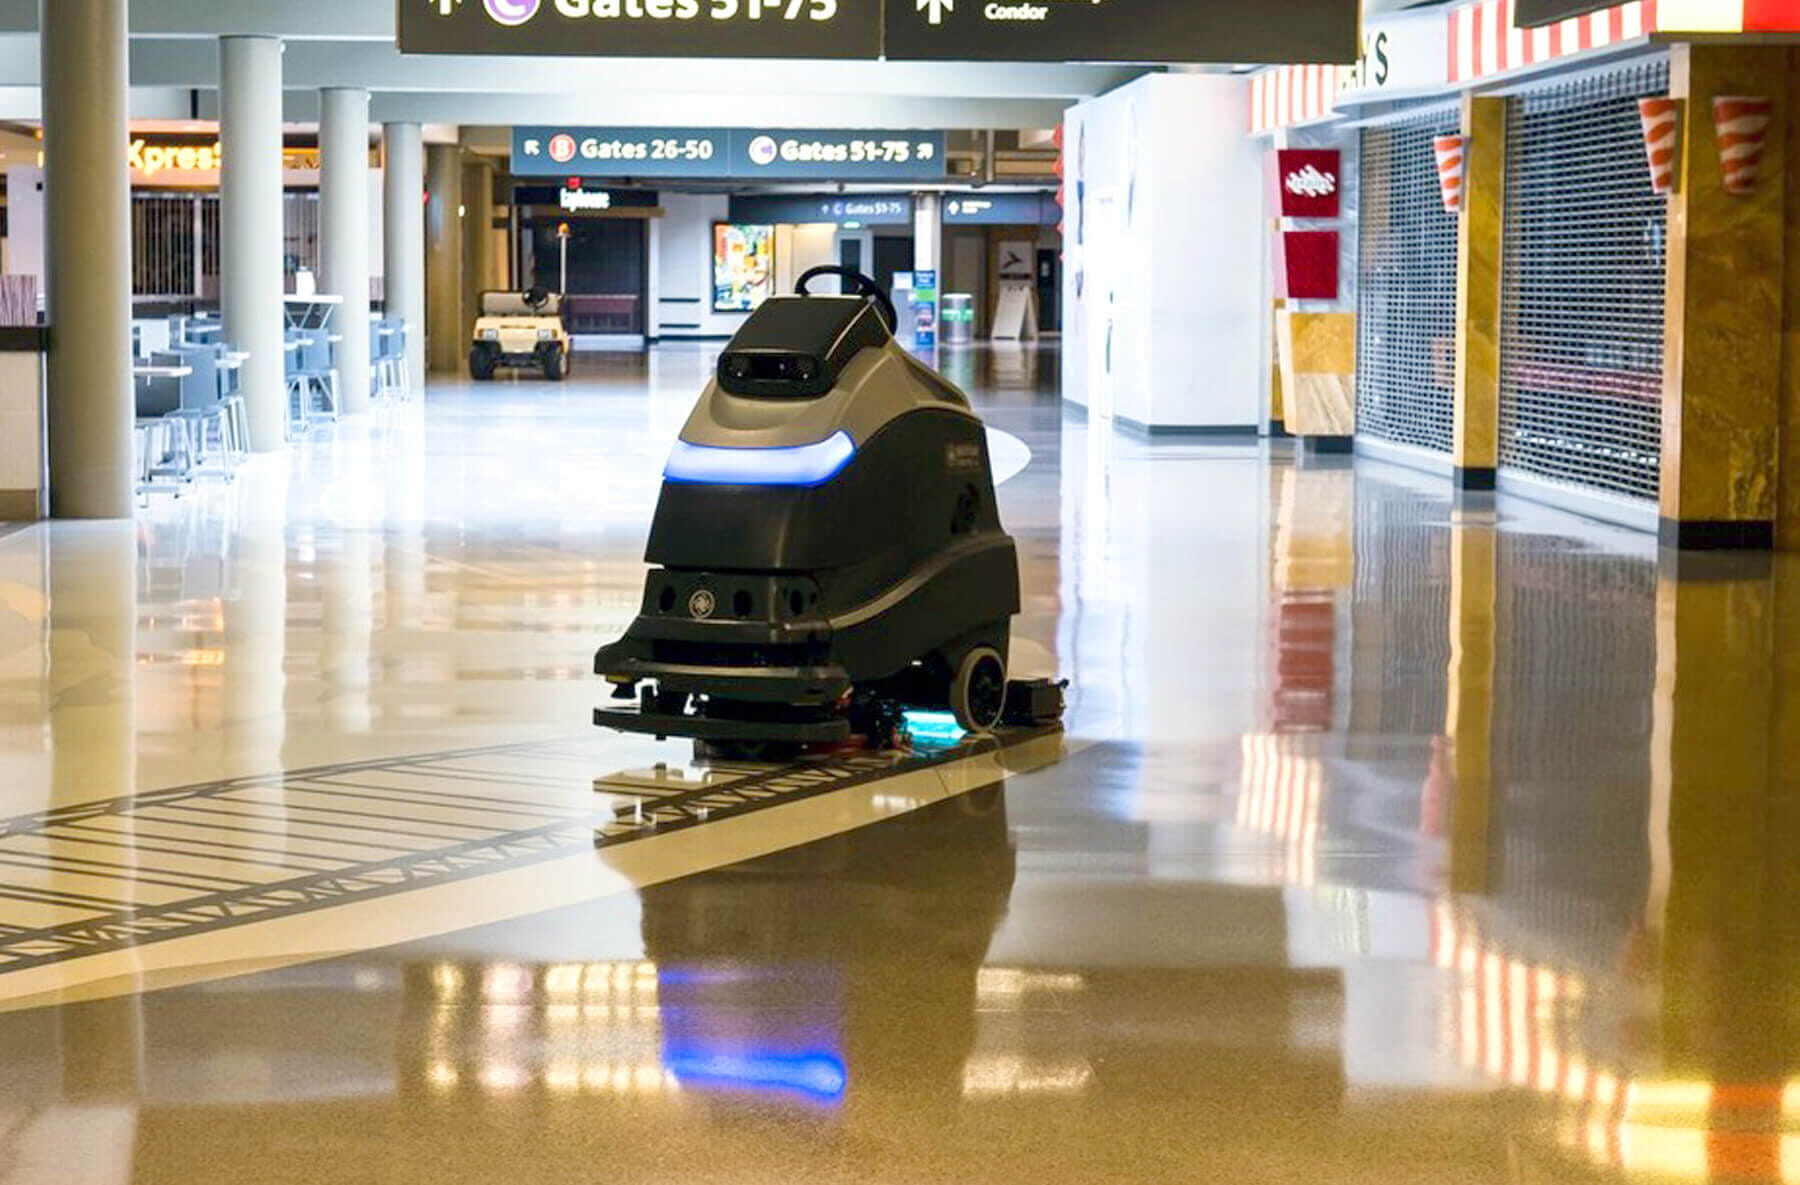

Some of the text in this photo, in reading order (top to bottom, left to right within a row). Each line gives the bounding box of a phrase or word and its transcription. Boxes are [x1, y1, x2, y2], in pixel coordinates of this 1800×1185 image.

[984, 3, 1049, 20] Condor
[129, 139, 221, 175] Xpres
[580, 138, 647, 159] Gates
[650, 139, 714, 159] 26-50
[780, 139, 848, 161] Gates
[850, 140, 910, 162] 51-75
